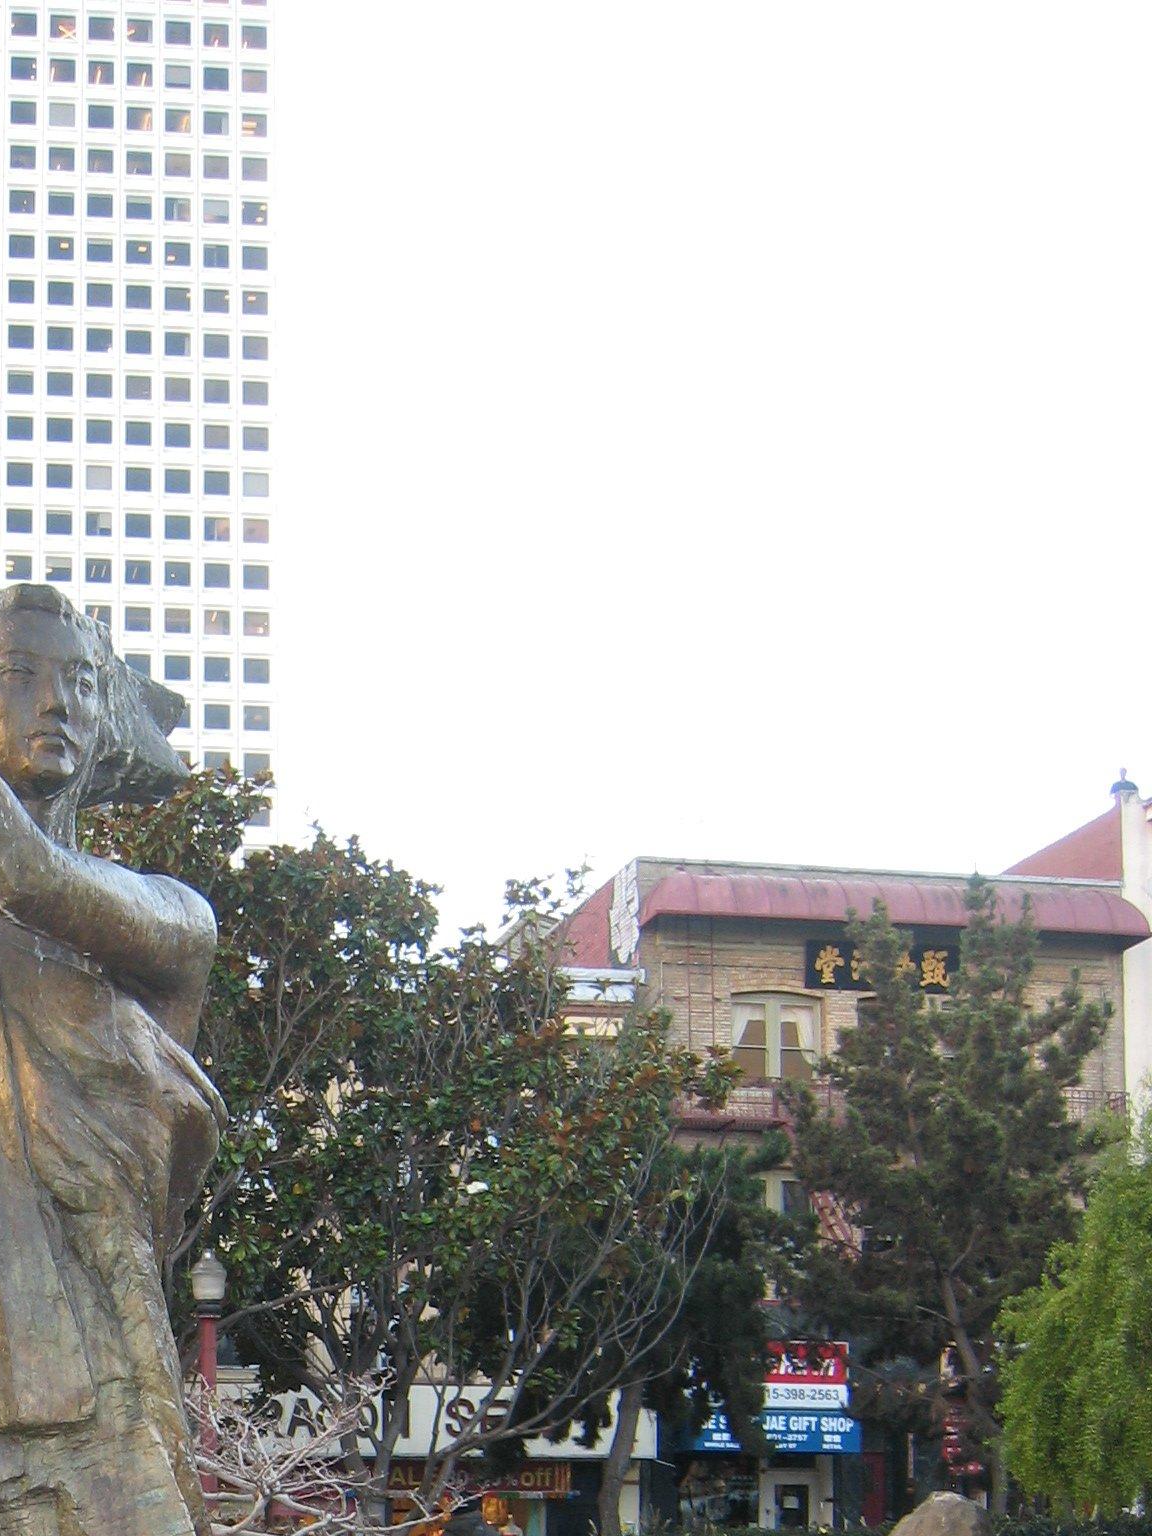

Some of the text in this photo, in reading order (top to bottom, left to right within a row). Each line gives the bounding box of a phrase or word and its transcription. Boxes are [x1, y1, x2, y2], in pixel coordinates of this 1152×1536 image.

[767, 1387, 840, 1400] 15-398-2563
[789, 1416, 818, 1431] GIFT
[820, 1417, 854, 1432] SHOP
